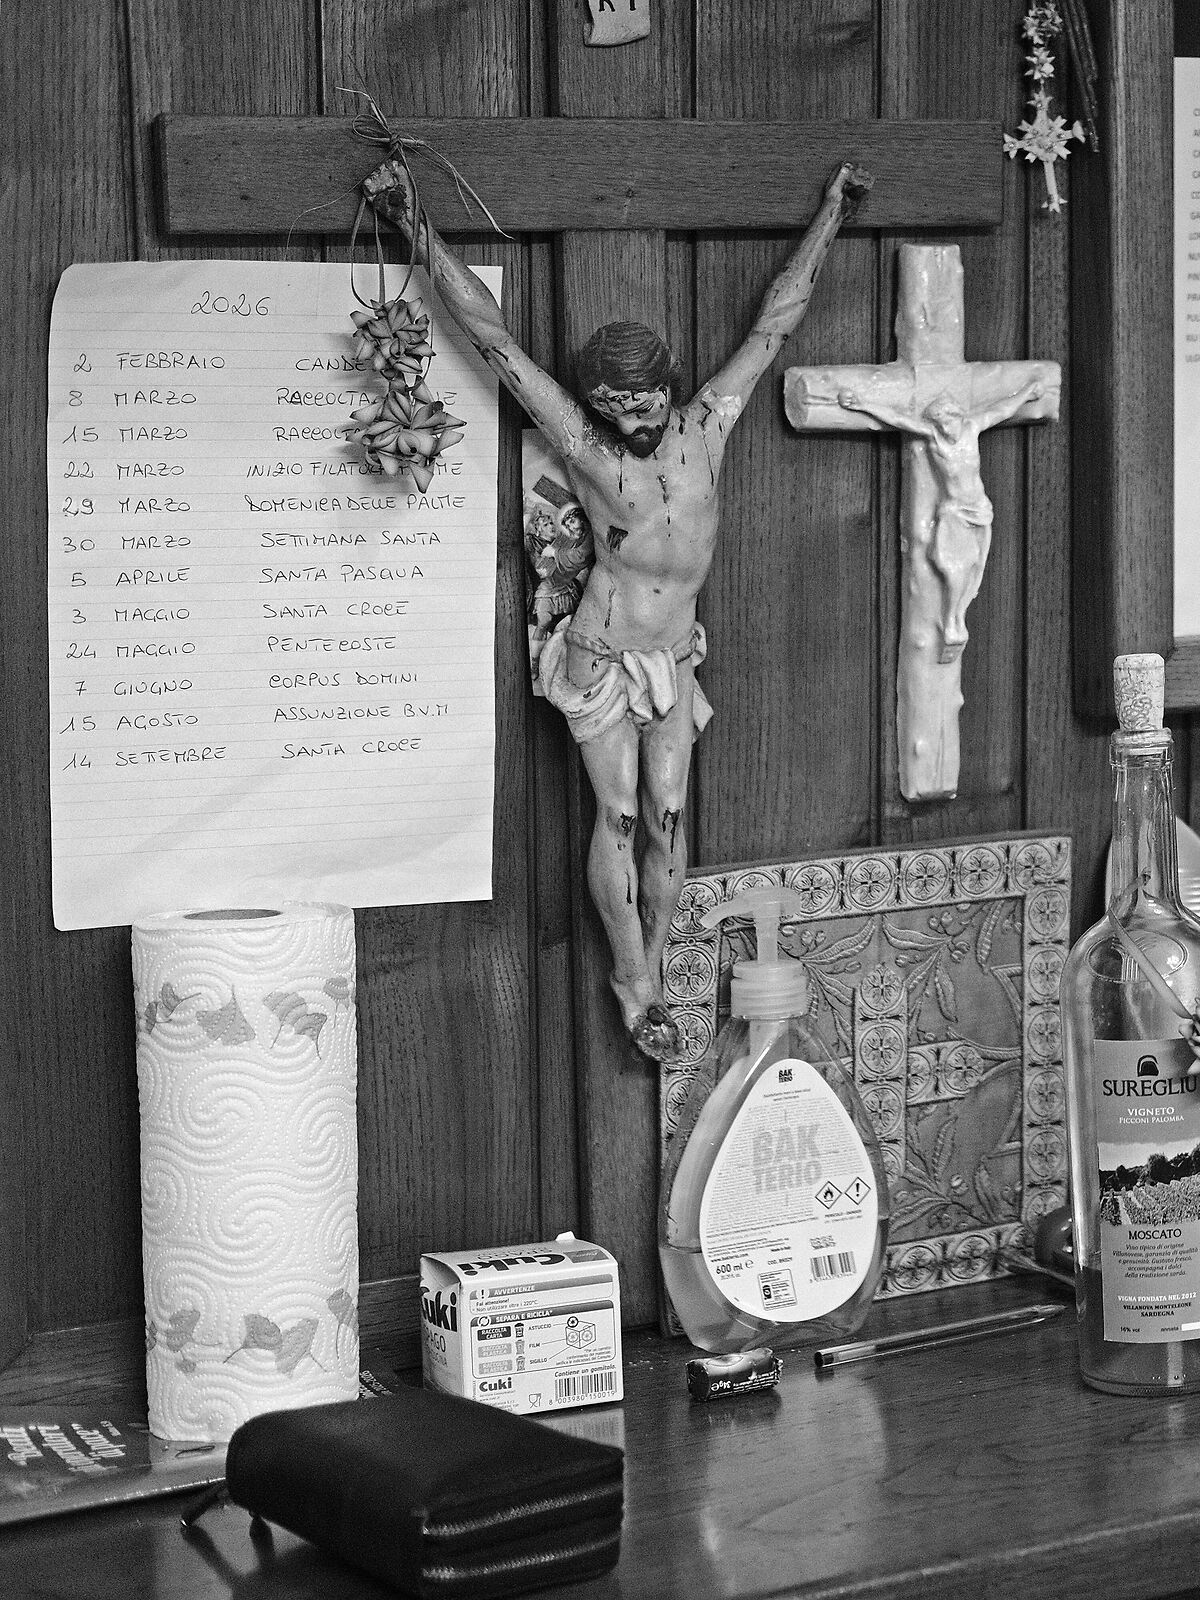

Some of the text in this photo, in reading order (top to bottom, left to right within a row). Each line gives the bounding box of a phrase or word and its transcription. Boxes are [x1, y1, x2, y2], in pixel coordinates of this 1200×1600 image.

[191, 291, 271, 316] 2026
[73, 352, 368, 372] 2 FEBBRAIO CANDE
[69, 388, 372, 407] 8 MARZO RACCOLTA
[62, 425, 98, 444] 15
[119, 426, 187, 442] MARZO
[64, 461, 302, 480] 22 MARZO INIZIO
[63, 490, 465, 516] 29 MARZO DOMENICA DELLE PALME
[63, 530, 440, 553] 30 MARZO SETTIMANA SANTA
[71, 564, 423, 587] 5 APRILE SANTA PASQUA
[73, 601, 409, 624] 3 MAGGIO SANTA CROCE
[66, 636, 396, 658] 24 MAGGIO PENTECOSTE
[75, 672, 417, 696] 7 GIUGNO CORPUS DOMINI
[59, 716, 96, 734] 15
[117, 713, 198, 731] AGOSTO
[274, 706, 390, 723] ASSUNZIONE
[63, 738, 421, 770] 14 SETTEMBRE SANTA CROCE
[778, 1068, 793, 1077] BAK
[1102, 1075, 1198, 1097] SUREGLIU
[1127, 1106, 1175, 1117] VIGNETO
[1151, 1115, 1184, 1123] PALOMBA
[752, 1122, 822, 1166] BAK
[1128, 1228, 1182, 1240] MOSCATO
[1164, 1242, 1185, 1250] origine
[457, 1253, 566, 1277] Cuki
[715, 1262, 743, 1275] 600 ml
[493, 1286, 536, 1296] AVVERTENZE
[1117, 1294, 1137, 1302] VIGNA
[1137, 1294, 1167, 1302] FONDATA
[1181, 1291, 1197, 1300] 2012
[1122, 1302, 1192, 1311] VILLANOVA MONTELEONE
[1140, 1310, 1175, 1318] SARDEGNA
[495, 1315, 520, 1323] SEPARA
[528, 1323, 552, 1331] ASTUCCIO
[481, 1327, 507, 1335] RACCOLTA
[529, 1357, 548, 1365] SIGILLO
[554, 1368, 580, 1378] Contiene
[581, 1367, 589, 1375] un
[479, 1376, 513, 1393] Cuki
